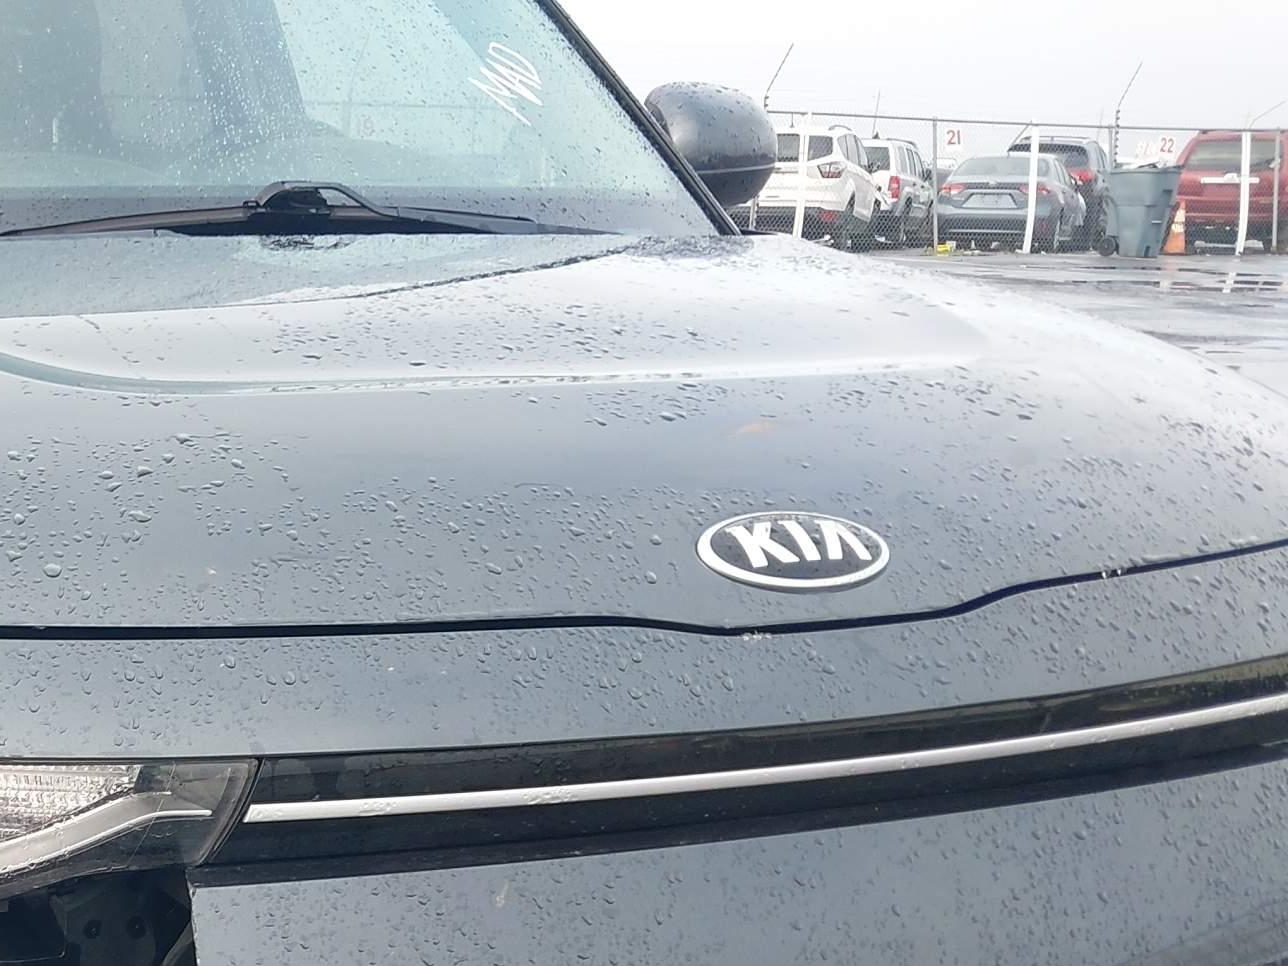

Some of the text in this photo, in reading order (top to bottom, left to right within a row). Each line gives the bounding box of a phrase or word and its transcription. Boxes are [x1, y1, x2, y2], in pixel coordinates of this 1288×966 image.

[946, 129, 961, 145] 21
[1159, 137, 1175, 153] 22
[725, 520, 873, 568] KIA
